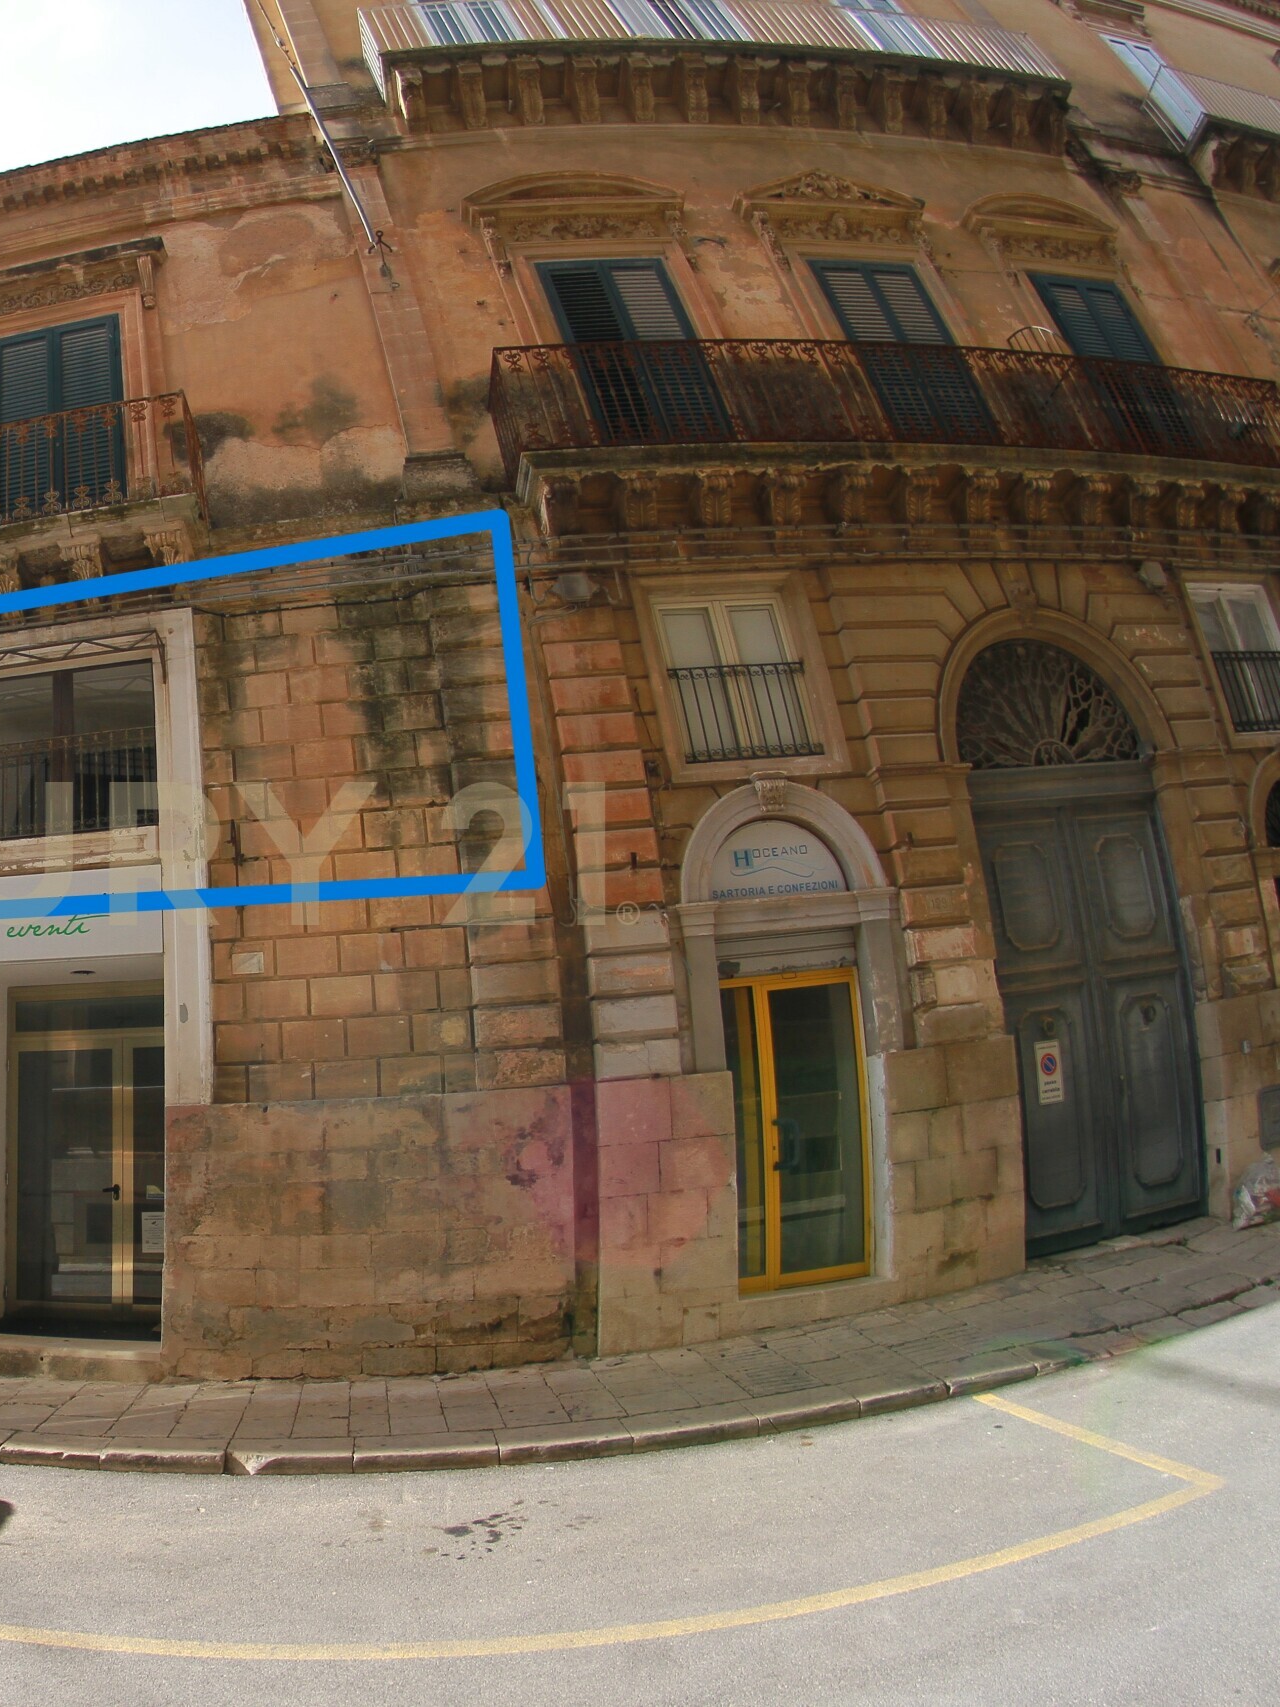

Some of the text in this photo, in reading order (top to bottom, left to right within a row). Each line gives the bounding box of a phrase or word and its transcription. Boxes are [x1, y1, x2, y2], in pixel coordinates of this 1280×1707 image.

[712, 880, 839, 900] SARTORIA E CONFEZIONI
[7, 914, 110, 938] eventi
